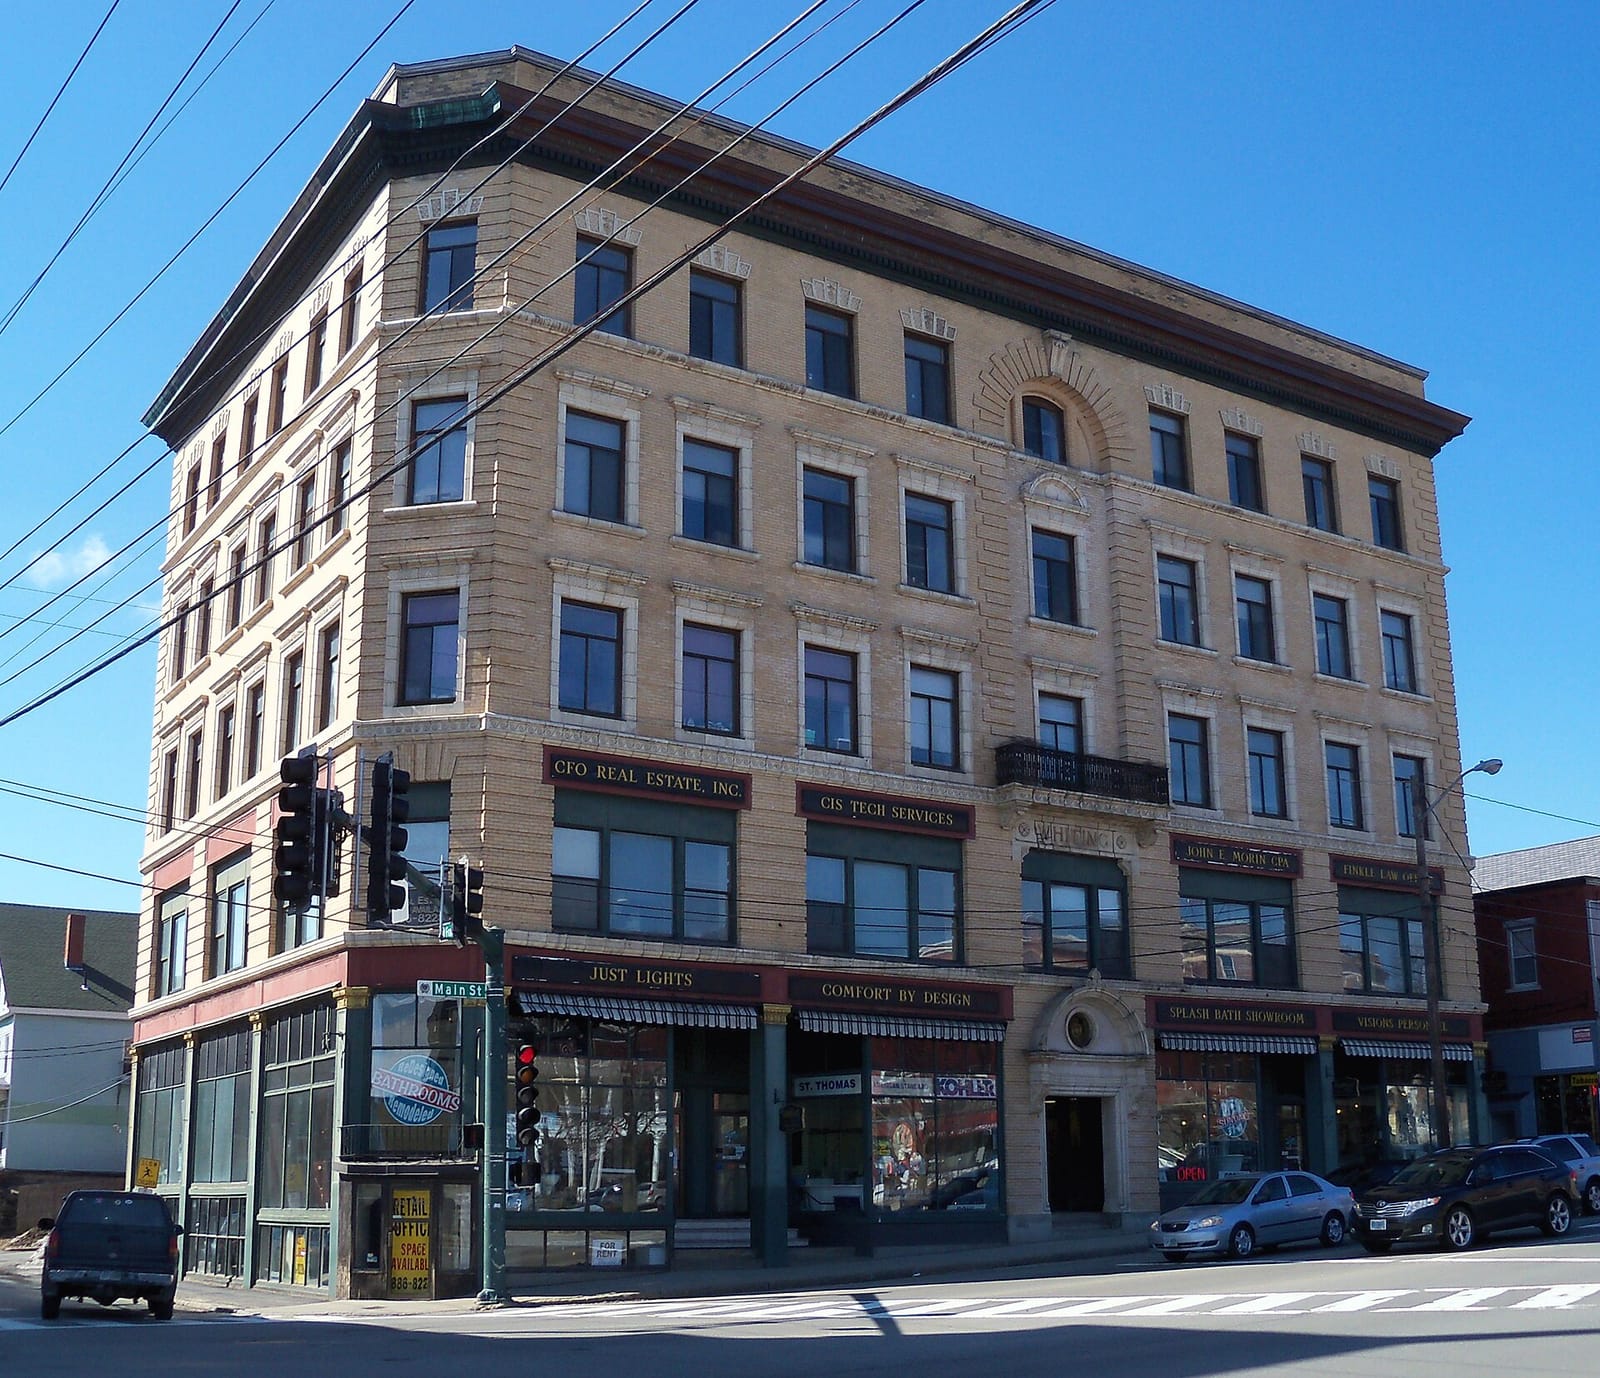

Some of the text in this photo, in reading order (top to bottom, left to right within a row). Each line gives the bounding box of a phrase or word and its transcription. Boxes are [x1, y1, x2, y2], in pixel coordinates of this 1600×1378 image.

[554, 760, 588, 776] CFO
[597, 765, 637, 783] REAL
[713, 781, 742, 798] INC.
[820, 796, 953, 825] CIS TECH SERVICES
[1188, 845, 1213, 859] JOHN
[1233, 851, 1266, 865] MORIN
[1271, 856, 1289, 868] CPA
[1381, 868, 1398, 881] LAW
[589, 967, 692, 986] JUST LIGHTS
[434, 984, 482, 997] Main St
[822, 983, 971, 1006] COMFORT BY DESIGN
[1170, 1007, 1305, 1024] SPLASH BATH SHOWROOM
[1358, 1016, 1394, 1029] VISIONS
[372, 1070, 461, 1111] BATHROOMS
[799, 1078, 856, 1092] ST. THOMAS
[937, 1077, 997, 1098] KOHLER
[1177, 1167, 1206, 1181] OPEN
[392, 1196, 428, 1217] RETAIL
[394, 1222, 430, 1237] OFFIC
[401, 1243, 427, 1256] SPACE
[596, 1249, 618, 1258] RENT
[600, 1242, 616, 1250] FOR
